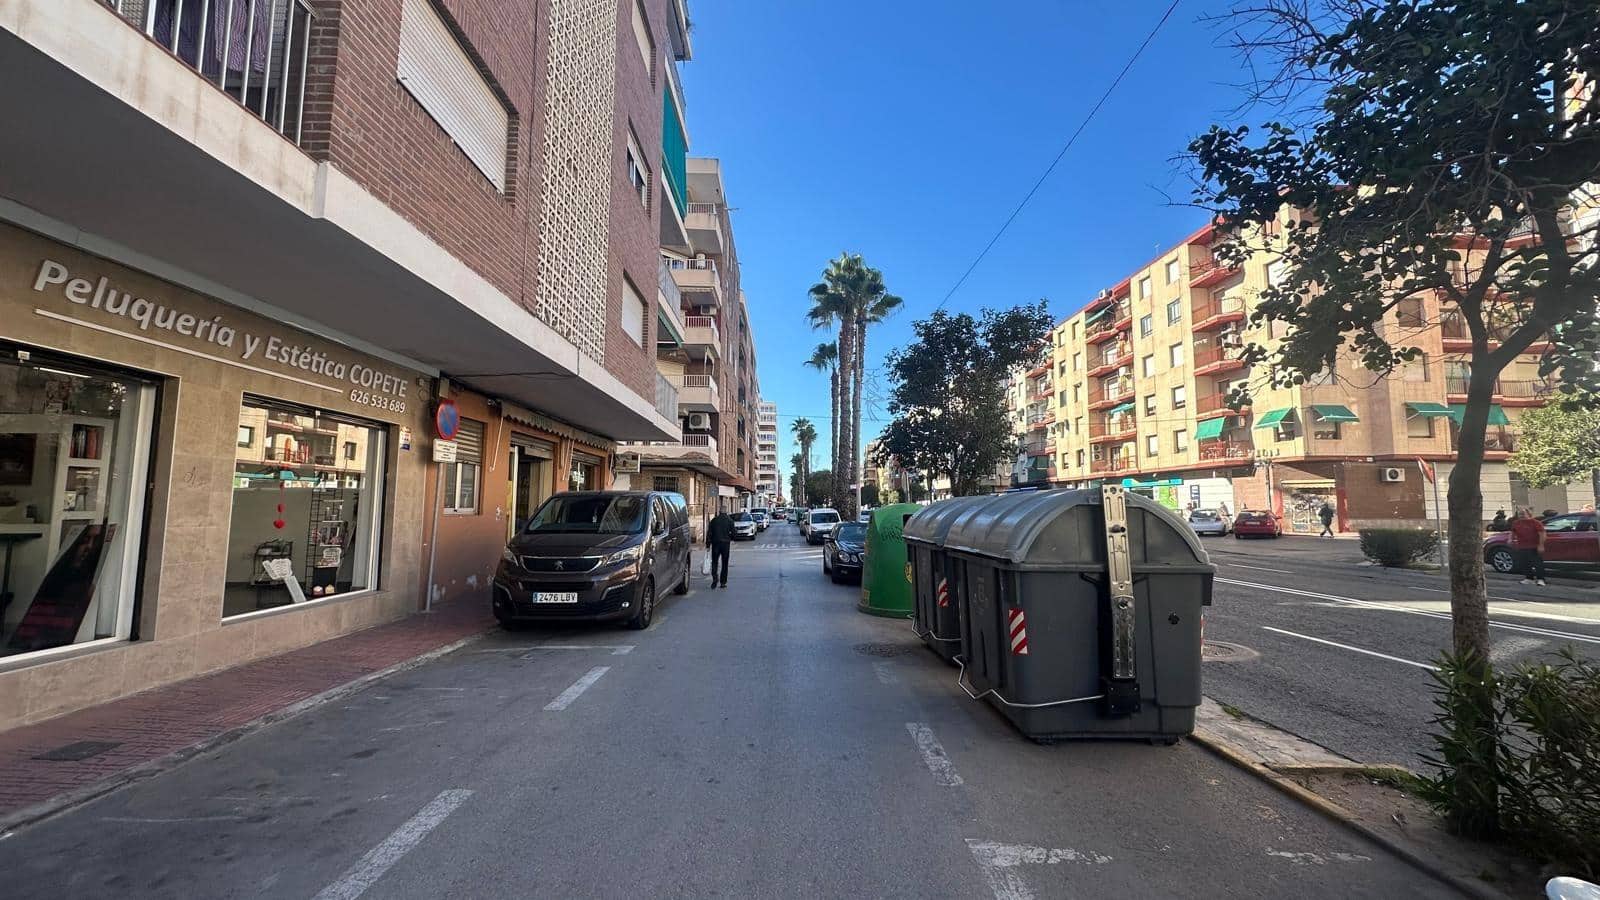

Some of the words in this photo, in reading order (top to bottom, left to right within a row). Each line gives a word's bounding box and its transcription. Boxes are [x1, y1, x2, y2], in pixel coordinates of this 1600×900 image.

[34, 259, 236, 348] Peluquería
[242, 333, 261, 360] y
[265, 335, 346, 380] Estética
[350, 364, 408, 398] COPETE
[350, 389, 369, 405] 626
[370, 394, 388, 410] 533
[389, 399, 406, 413] 689
[539, 593, 559, 601] 2476
